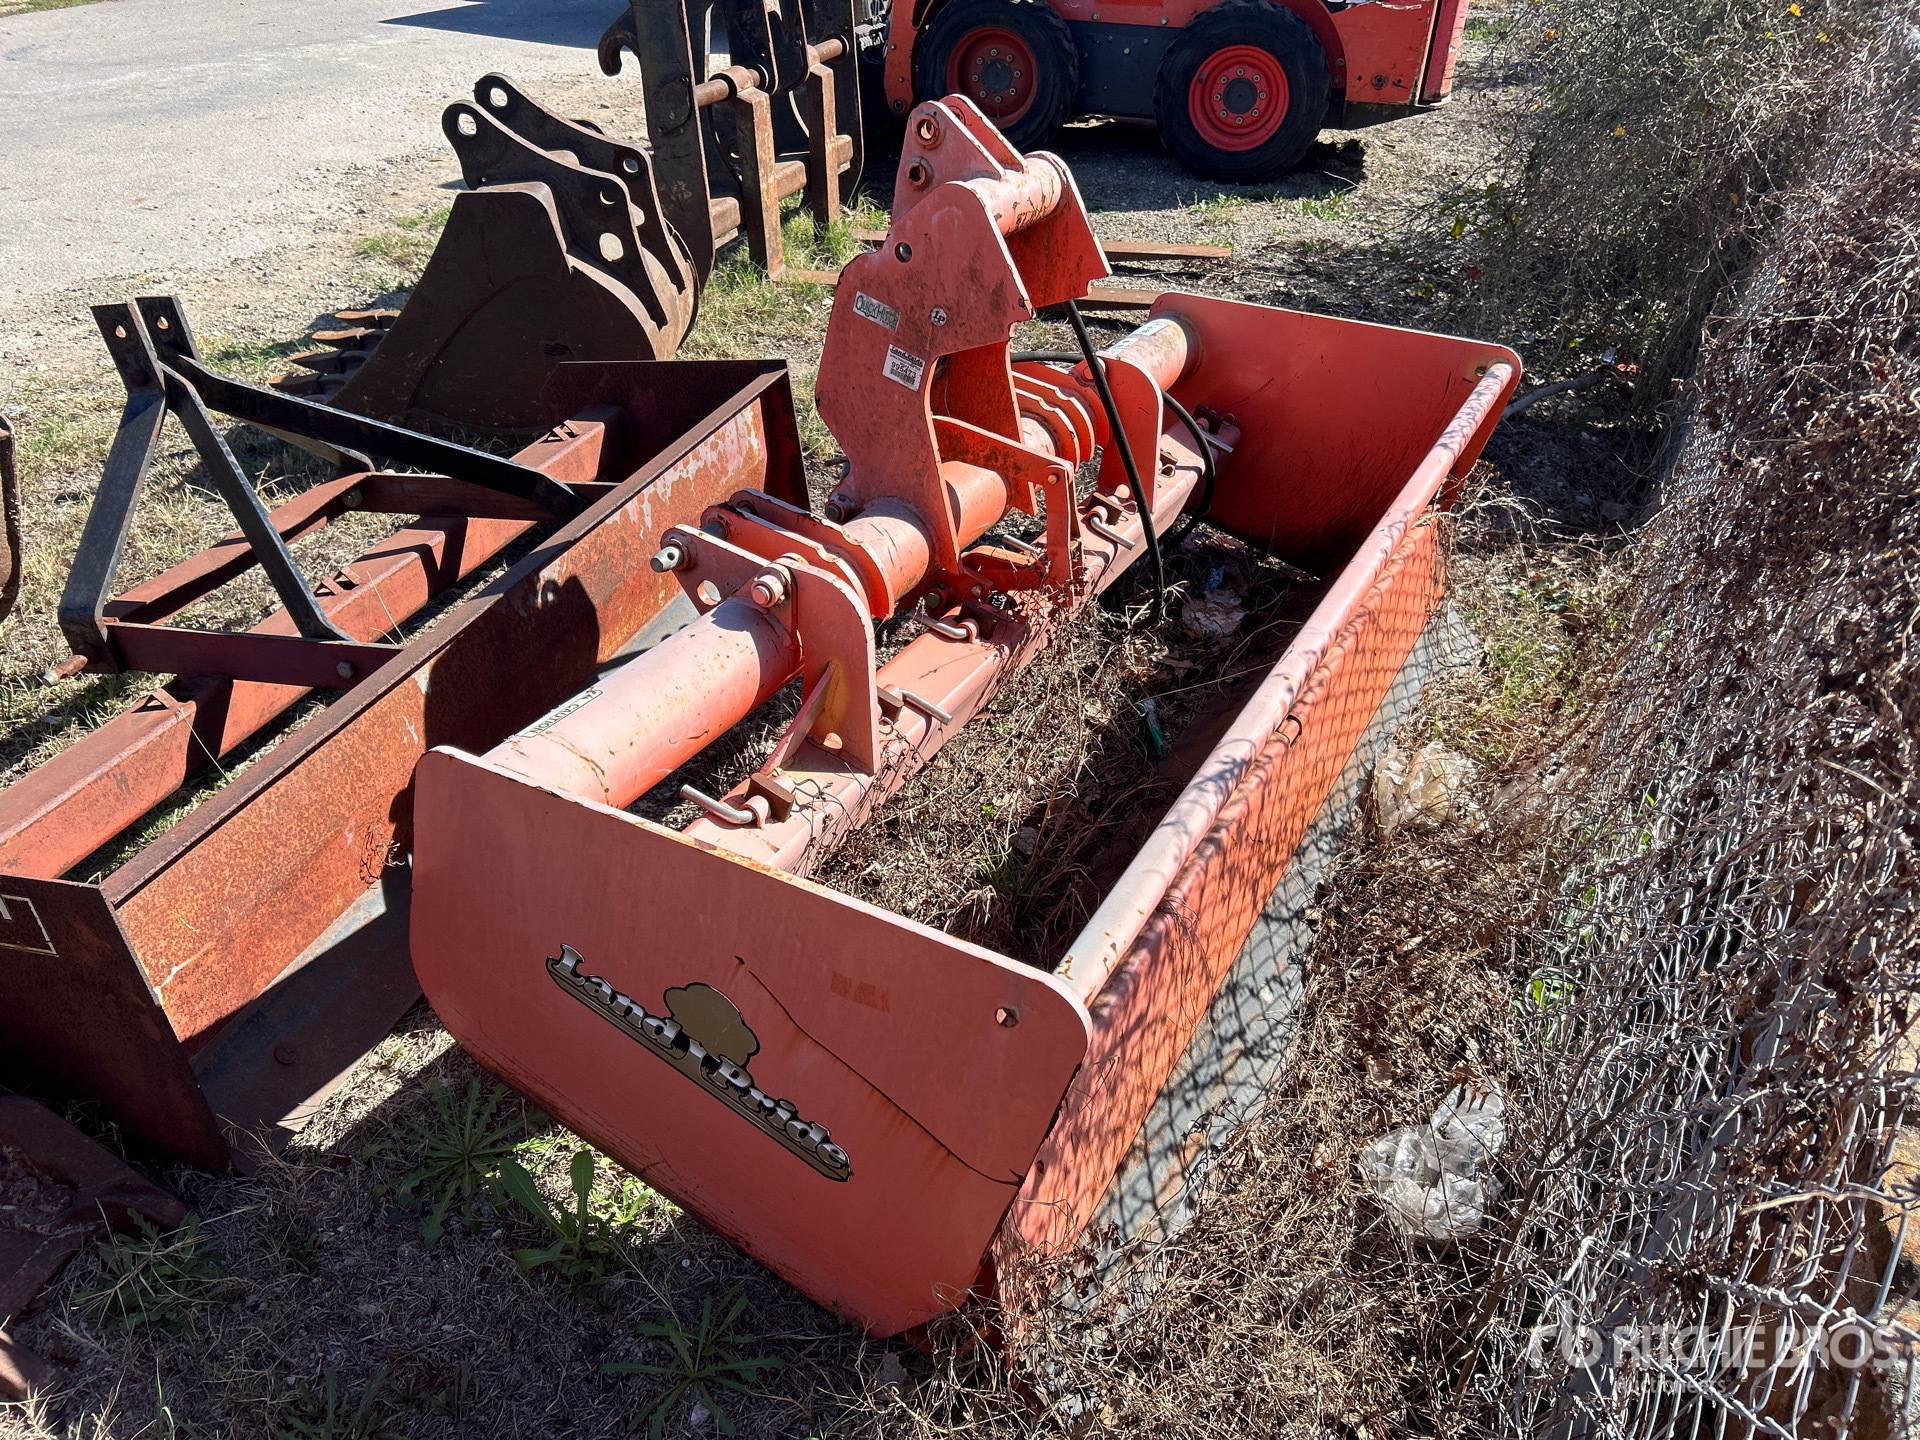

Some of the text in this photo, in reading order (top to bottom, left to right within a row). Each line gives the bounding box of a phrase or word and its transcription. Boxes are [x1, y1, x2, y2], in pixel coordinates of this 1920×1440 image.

[891, 361, 917, 379] 995473
[529, 703, 580, 734] CAUTION
[546, 943, 851, 1171] Land Pride
